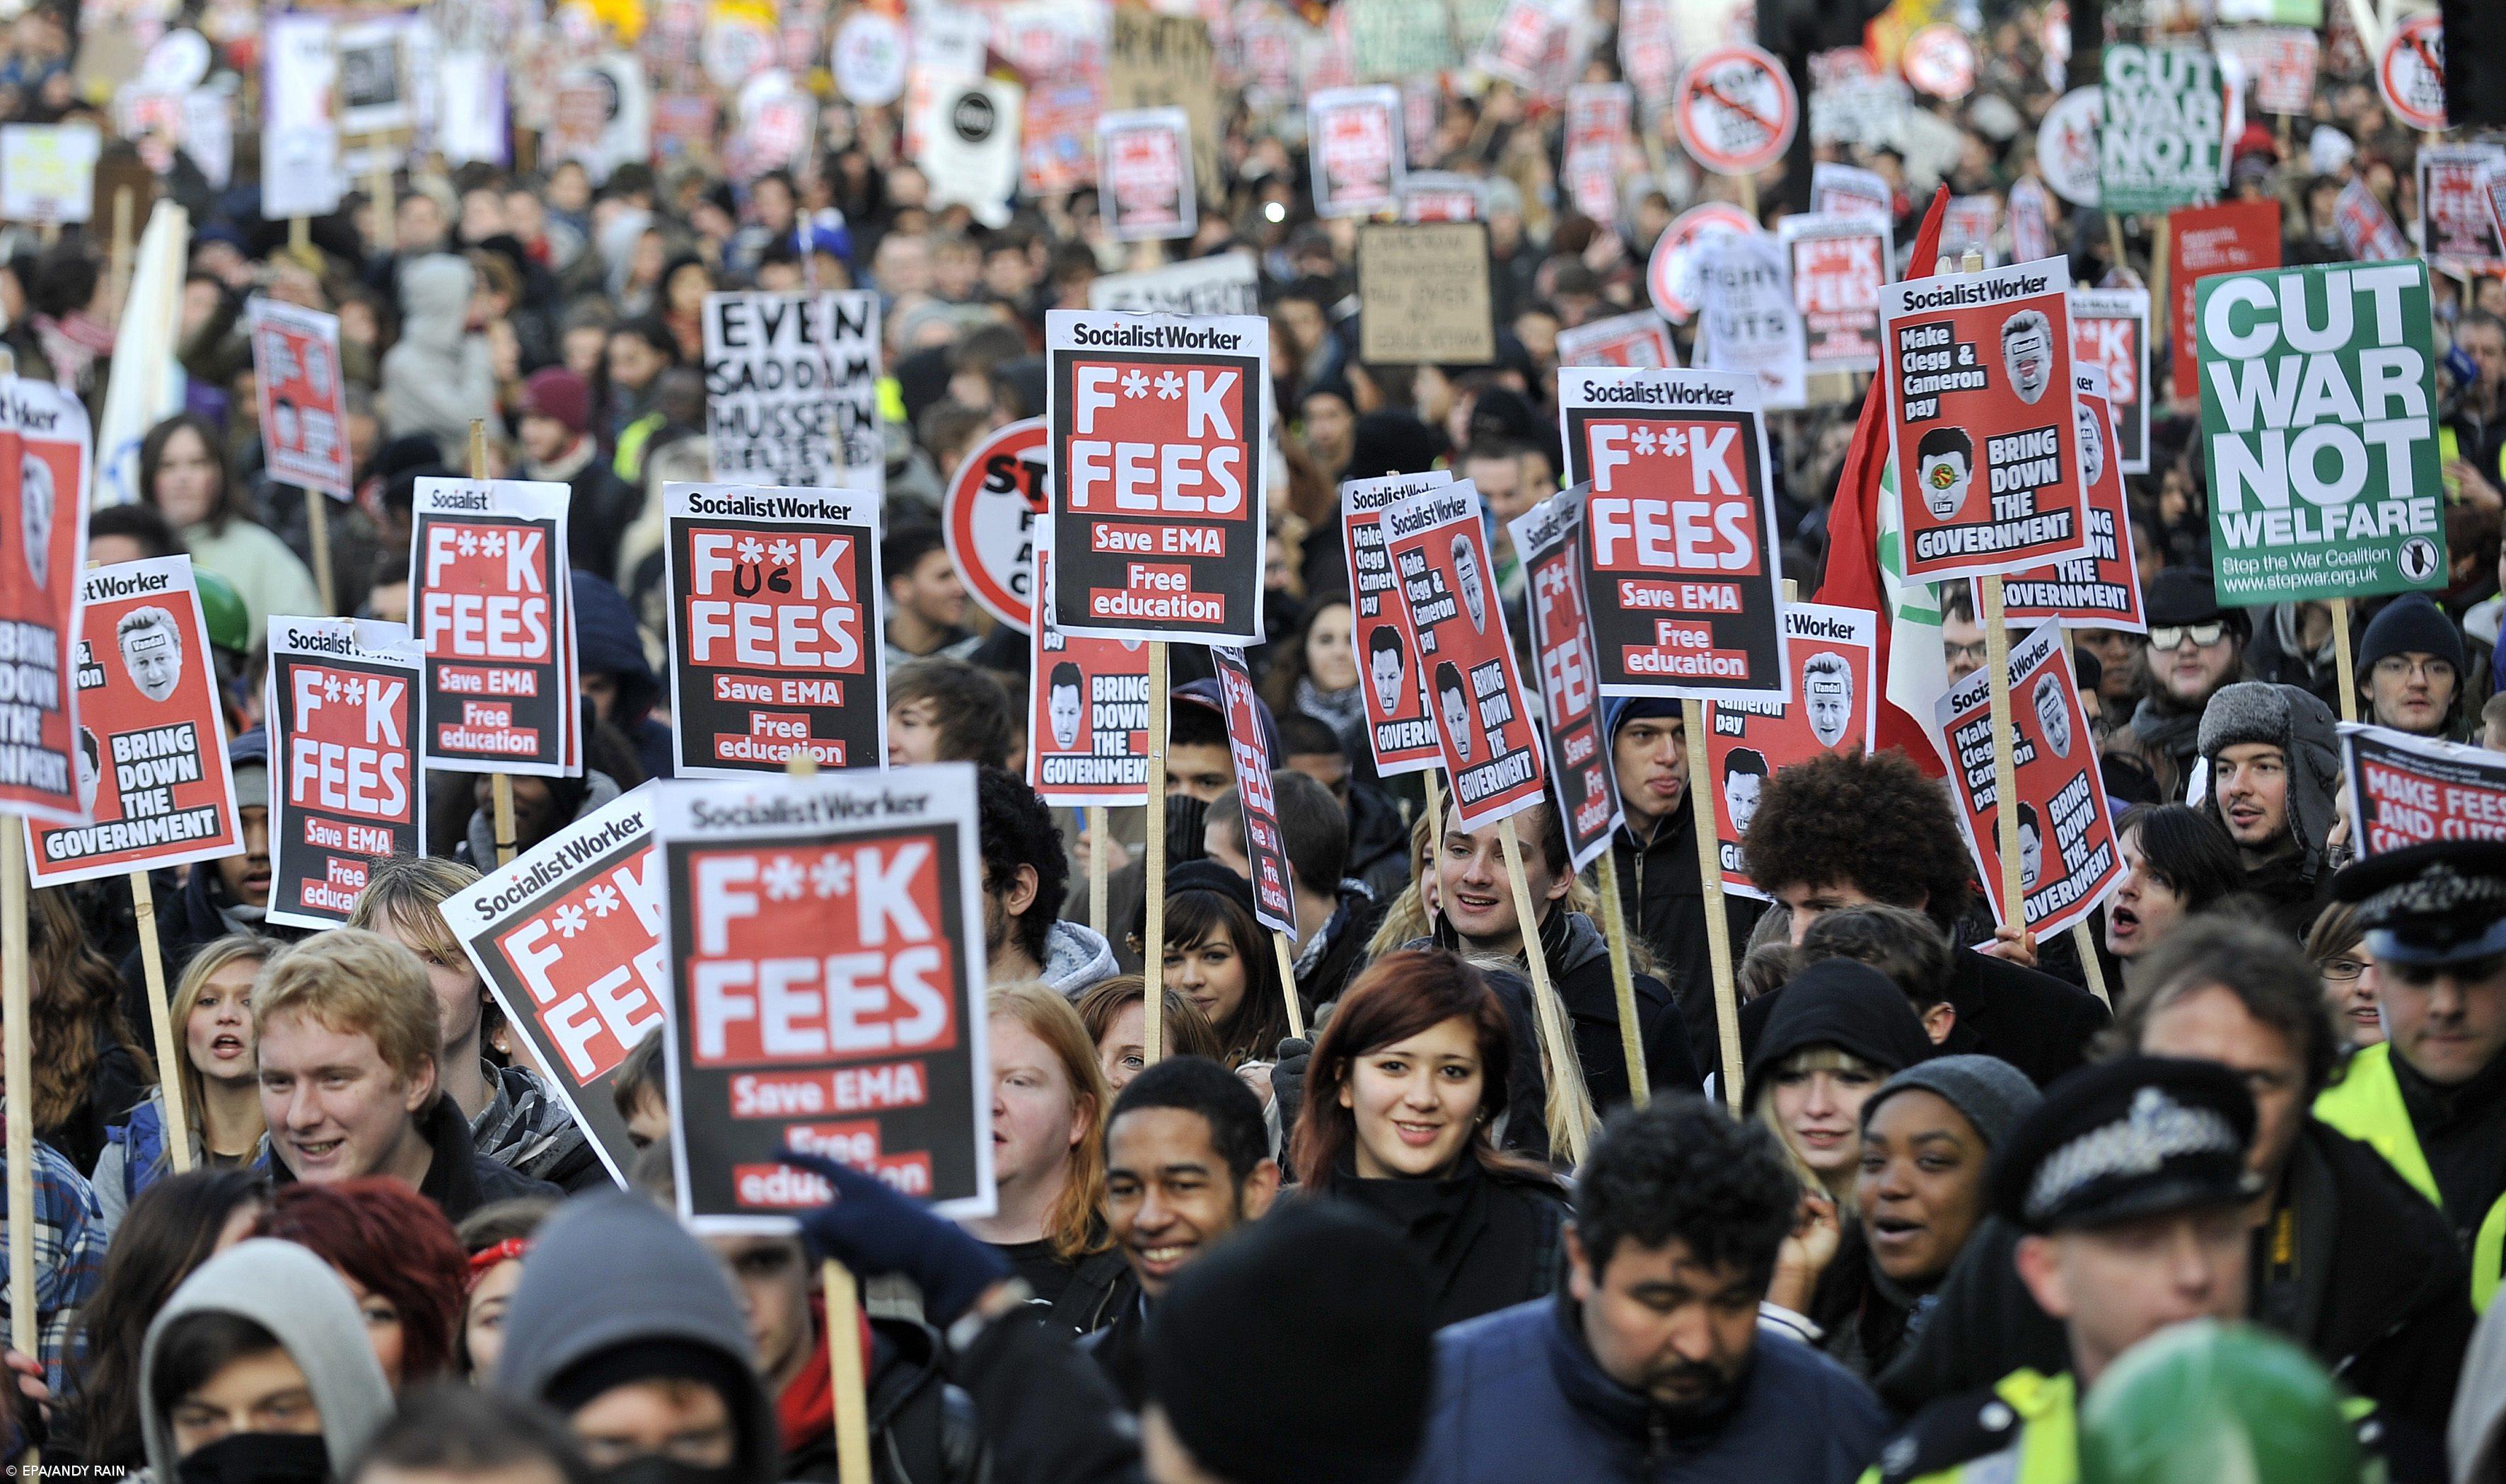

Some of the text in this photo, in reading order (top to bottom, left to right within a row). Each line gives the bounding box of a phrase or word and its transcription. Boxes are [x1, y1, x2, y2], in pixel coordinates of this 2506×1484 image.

[1903, 274, 2048, 311] Socialist Worker
[721, 300, 869, 347] EVEN
[2204, 265, 2420, 360] CUT
[1074, 323, 1241, 350] Socialist Worker
[1900, 327, 1949, 352] Make
[1903, 346, 1975, 372] Clegg &
[1583, 379, 1734, 406] Socialist Worker
[1904, 370, 1985, 395] Cameron
[2207, 345, 2428, 433] WAR
[1905, 396, 1938, 421] pay
[1988, 429, 2057, 465] BRING
[1071, 439, 1241, 514] FEES
[1990, 458, 2057, 492] DOWN
[2212, 417, 2430, 514] NOT
[431, 489, 488, 511] Socialist
[689, 492, 852, 521] Socialist Worker
[1352, 485, 1405, 510] Socialist
[1993, 491, 2032, 521] THE
[1391, 496, 1467, 536] Socialist Worker
[2217, 497, 2437, 550] WELFARE
[1095, 524, 1221, 554] Save EMA
[1353, 526, 1383, 548] Make
[1591, 497, 1753, 569] FEES
[1916, 513, 2070, 559] GOVERNMENT
[1355, 549, 1386, 570] Clegg
[1398, 552, 1426, 578] Make
[2055, 560, 2096, 582] THE
[2222, 546, 2391, 578] Stop the War Coalition
[95, 572, 168, 598] Worker
[1131, 564, 1186, 591] Free
[1405, 578, 1432, 603] Clegg
[1432, 571, 1445, 593] &
[2223, 566, 2379, 594] www.stopwar.org.uk
[1094, 591, 1220, 620] education
[1360, 596, 1379, 617] pay
[1621, 582, 1739, 610] Save EMA
[425, 592, 547, 659] FEES
[1412, 597, 1456, 626] Cameron
[288, 628, 352, 656] Socialist
[691, 601, 859, 668] FEES
[1419, 630, 1436, 654] pay
[1657, 622, 1710, 649] Free
[1793, 615, 1855, 639] Worker
[1627, 648, 1746, 676] education
[2014, 638, 2050, 680] Worker
[439, 668, 535, 695] Save EMA
[717, 677, 840, 705] Save EMA
[1091, 676, 1149, 702] BRING
[1471, 662, 1504, 698] BRING
[1814, 683, 1841, 694] Vandal
[464, 703, 509, 729] Free
[1092, 705, 1149, 730] DOWN
[1479, 692, 1512, 729] DOWN
[1715, 712, 1744, 735] pay
[440, 726, 537, 754] education
[753, 714, 806, 738] Free
[112, 726, 195, 763] BRING
[718, 736, 842, 765] education
[1092, 731, 1127, 756] THE
[1486, 728, 1507, 759] THE
[117, 754, 198, 792] DOWN
[292, 738, 407, 817] FEES
[1231, 741, 1275, 817] FEES
[1457, 751, 1532, 803] GOVERNMENT
[122, 786, 171, 821] THE
[2050, 771, 2089, 821] BRING
[2366, 766, 2440, 812] MAKE
[691, 790, 929, 830] Socialist Worker
[2056, 800, 2096, 850] DOWN
[2379, 800, 2435, 840] AND
[46, 809, 216, 860] GOVERNMENT
[306, 819, 390, 854] Save EMA
[474, 809, 646, 921] Socialist Worker
[2063, 840, 2089, 874] THE
[327, 859, 366, 888] Free
[2020, 871, 2034, 883] iar
[2023, 841, 2112, 924] OVERNMENT
[695, 945, 947, 1060] FEES
[733, 1069, 922, 1113] Save EMA
